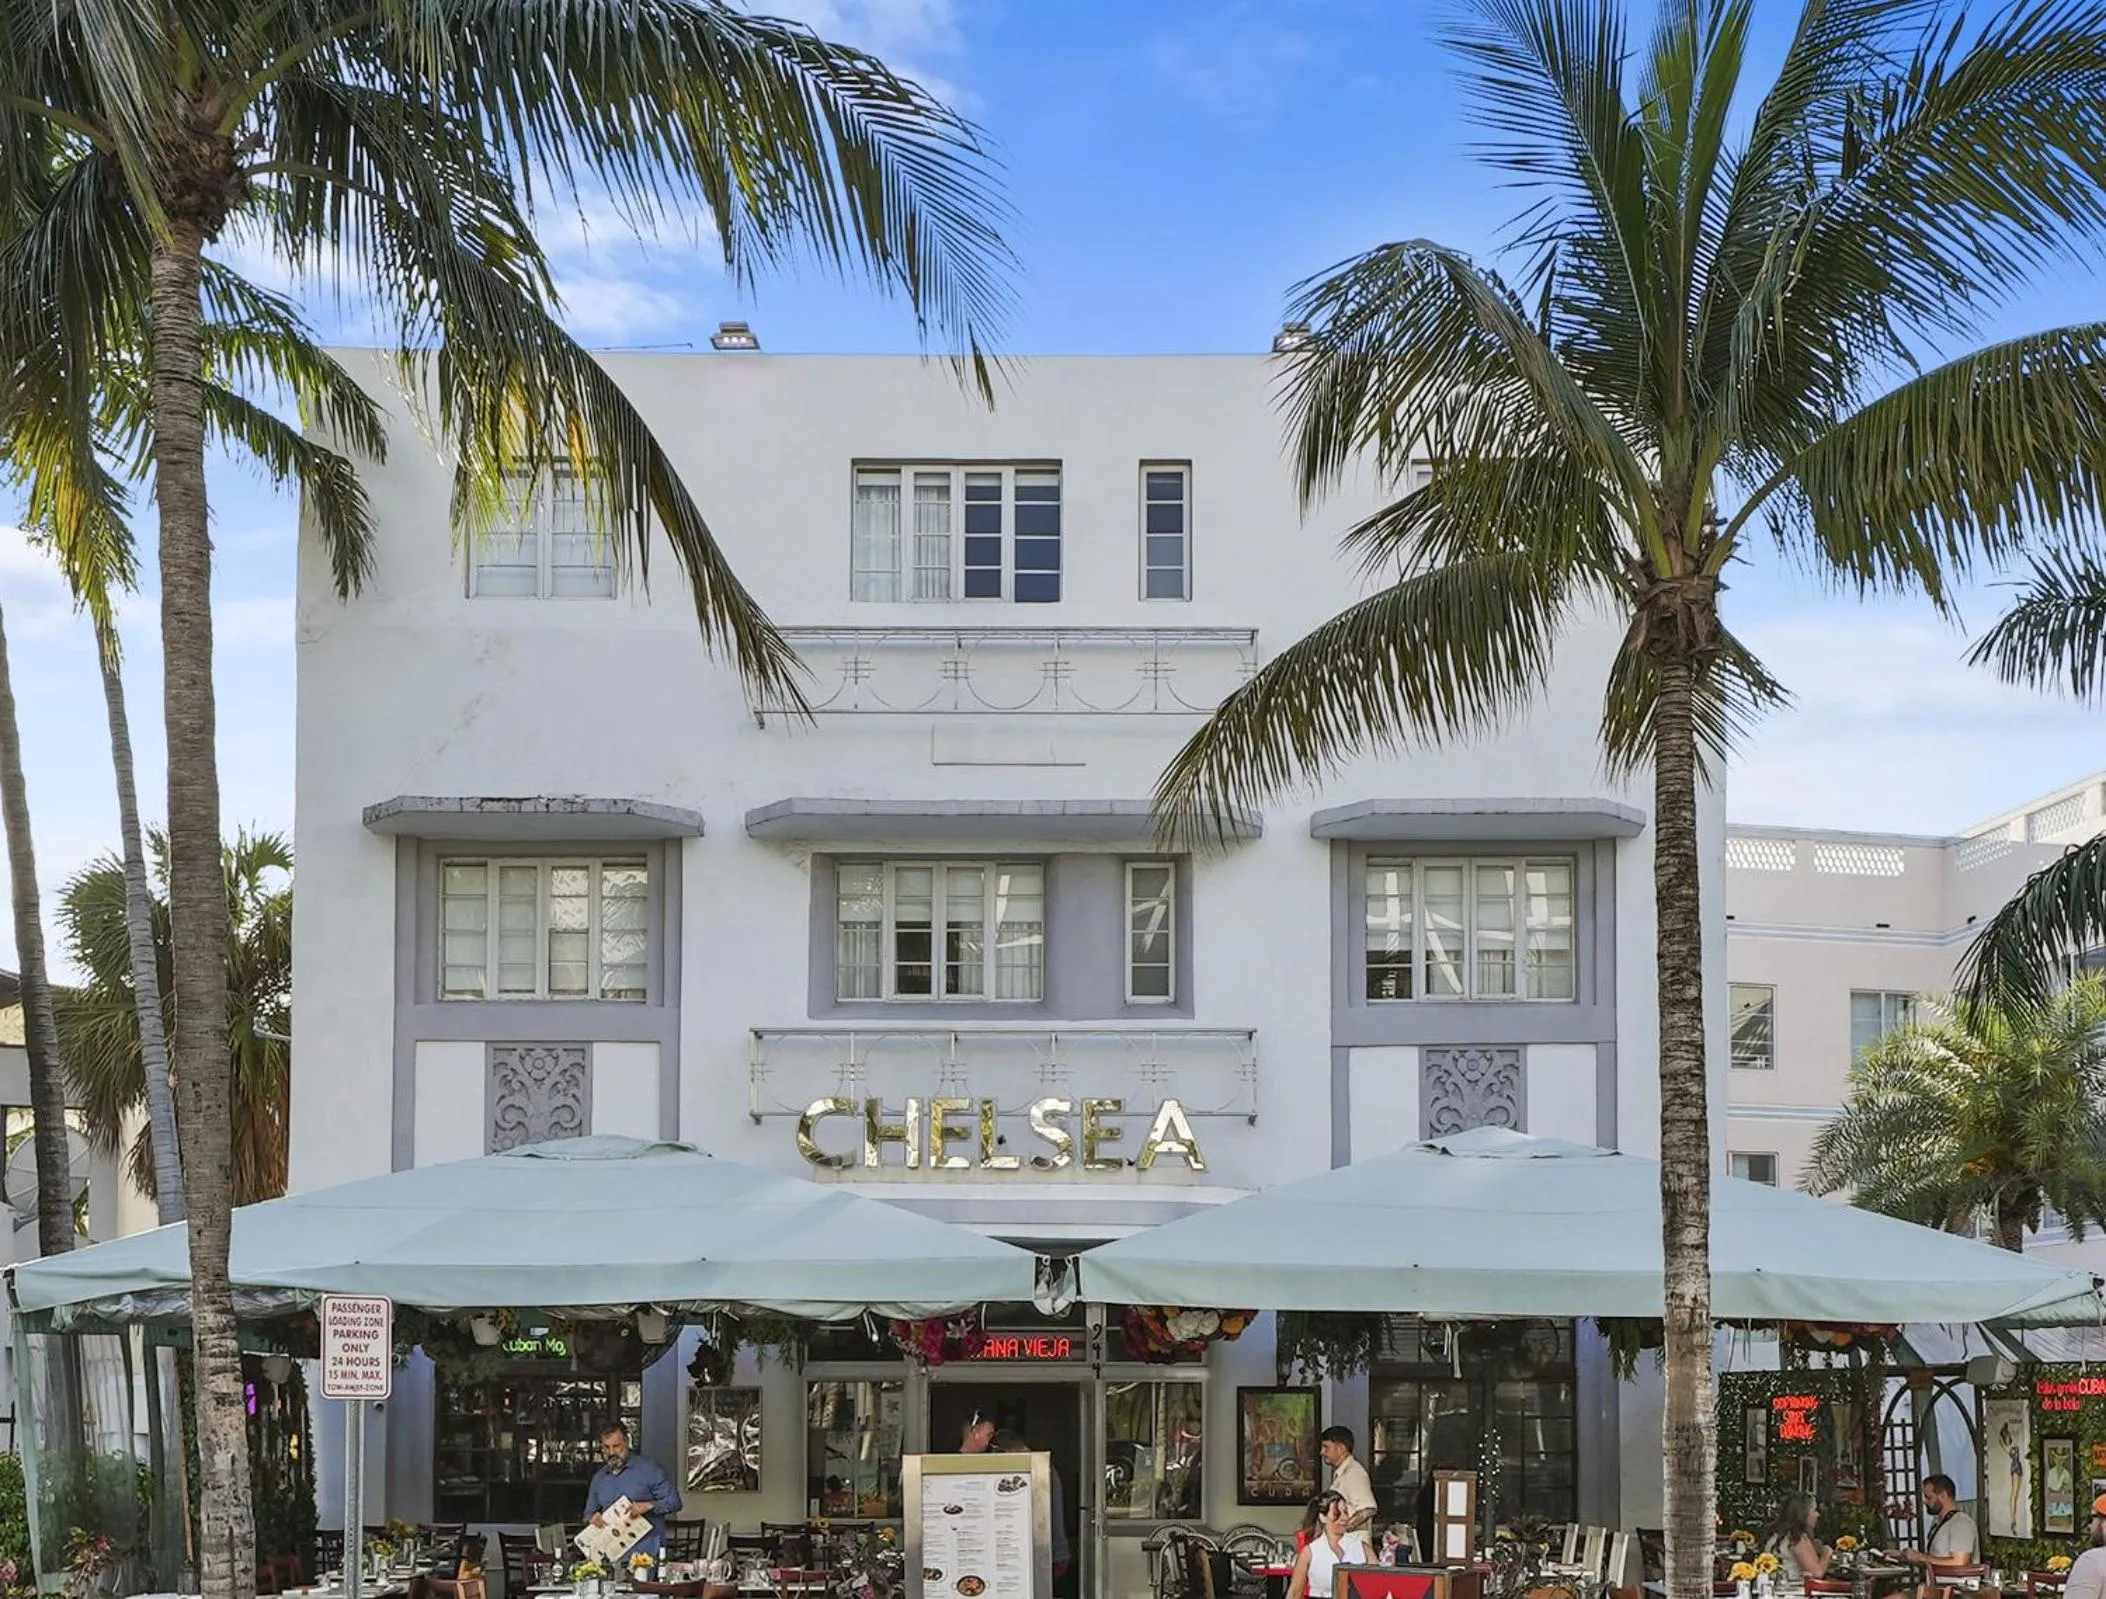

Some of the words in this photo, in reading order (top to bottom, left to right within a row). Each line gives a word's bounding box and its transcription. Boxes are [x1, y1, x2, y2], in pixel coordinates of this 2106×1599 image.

[797, 1097, 1207, 1170] CHELSEA
[331, 1303, 382, 1314] PASSENGER
[329, 1317, 361, 1326] LOADING
[364, 1317, 384, 1327] ZONE
[333, 1330, 379, 1340] PARKING
[342, 1343, 370, 1353] ONLY
[972, 1338, 1019, 1358] ANA
[1023, 1338, 1070, 1358] VIEJA
[332, 1357, 343, 1366] 24
[346, 1357, 380, 1367] HOURS
[329, 1370, 339, 1380] 15
